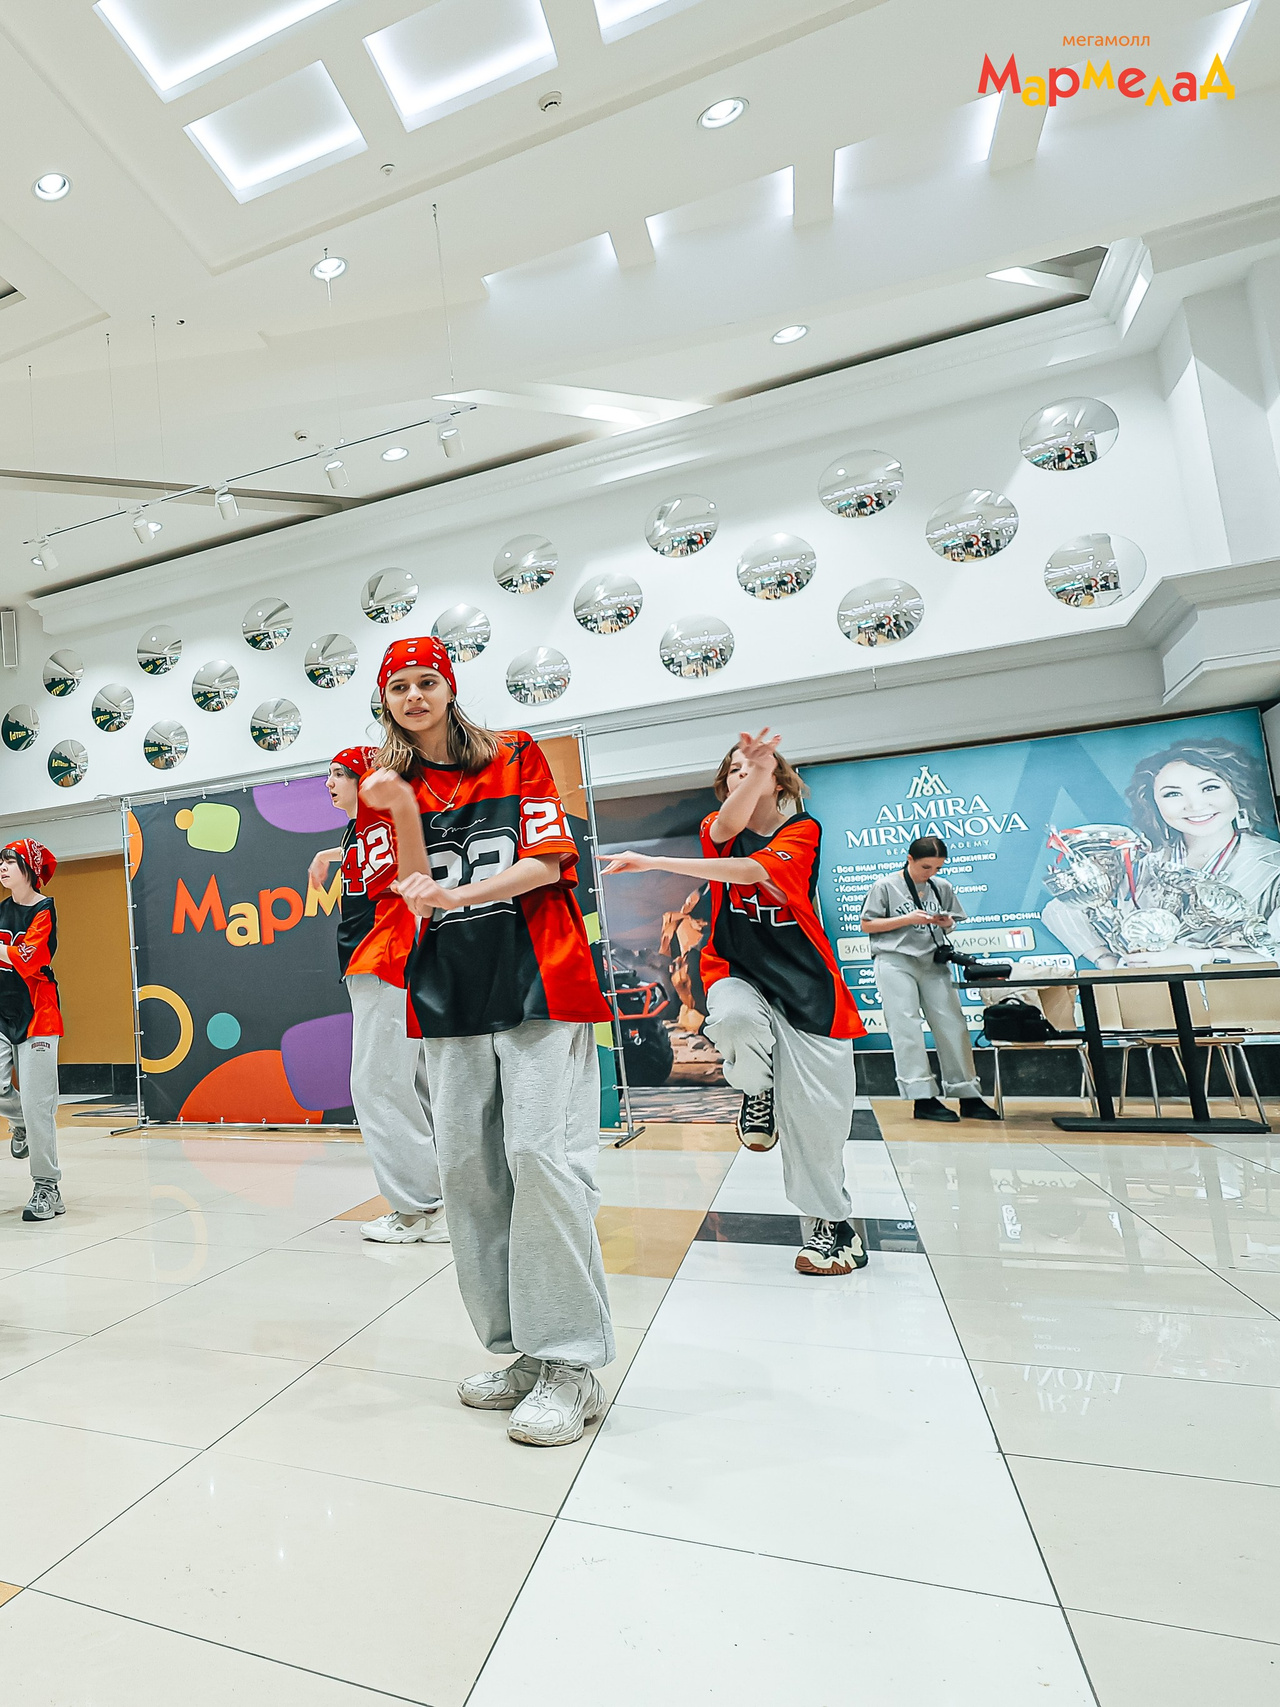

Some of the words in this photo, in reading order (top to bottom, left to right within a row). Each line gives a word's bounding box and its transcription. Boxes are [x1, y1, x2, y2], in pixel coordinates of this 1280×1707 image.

[875, 794, 991, 825] ALMIRA
[845, 812, 1030, 848] MIRMANOVA
[952, 852, 997, 863] макияжа
[836, 865, 854, 874] Все
[855, 863, 876, 873] виды
[1001, 911, 1041, 923] ресниц
